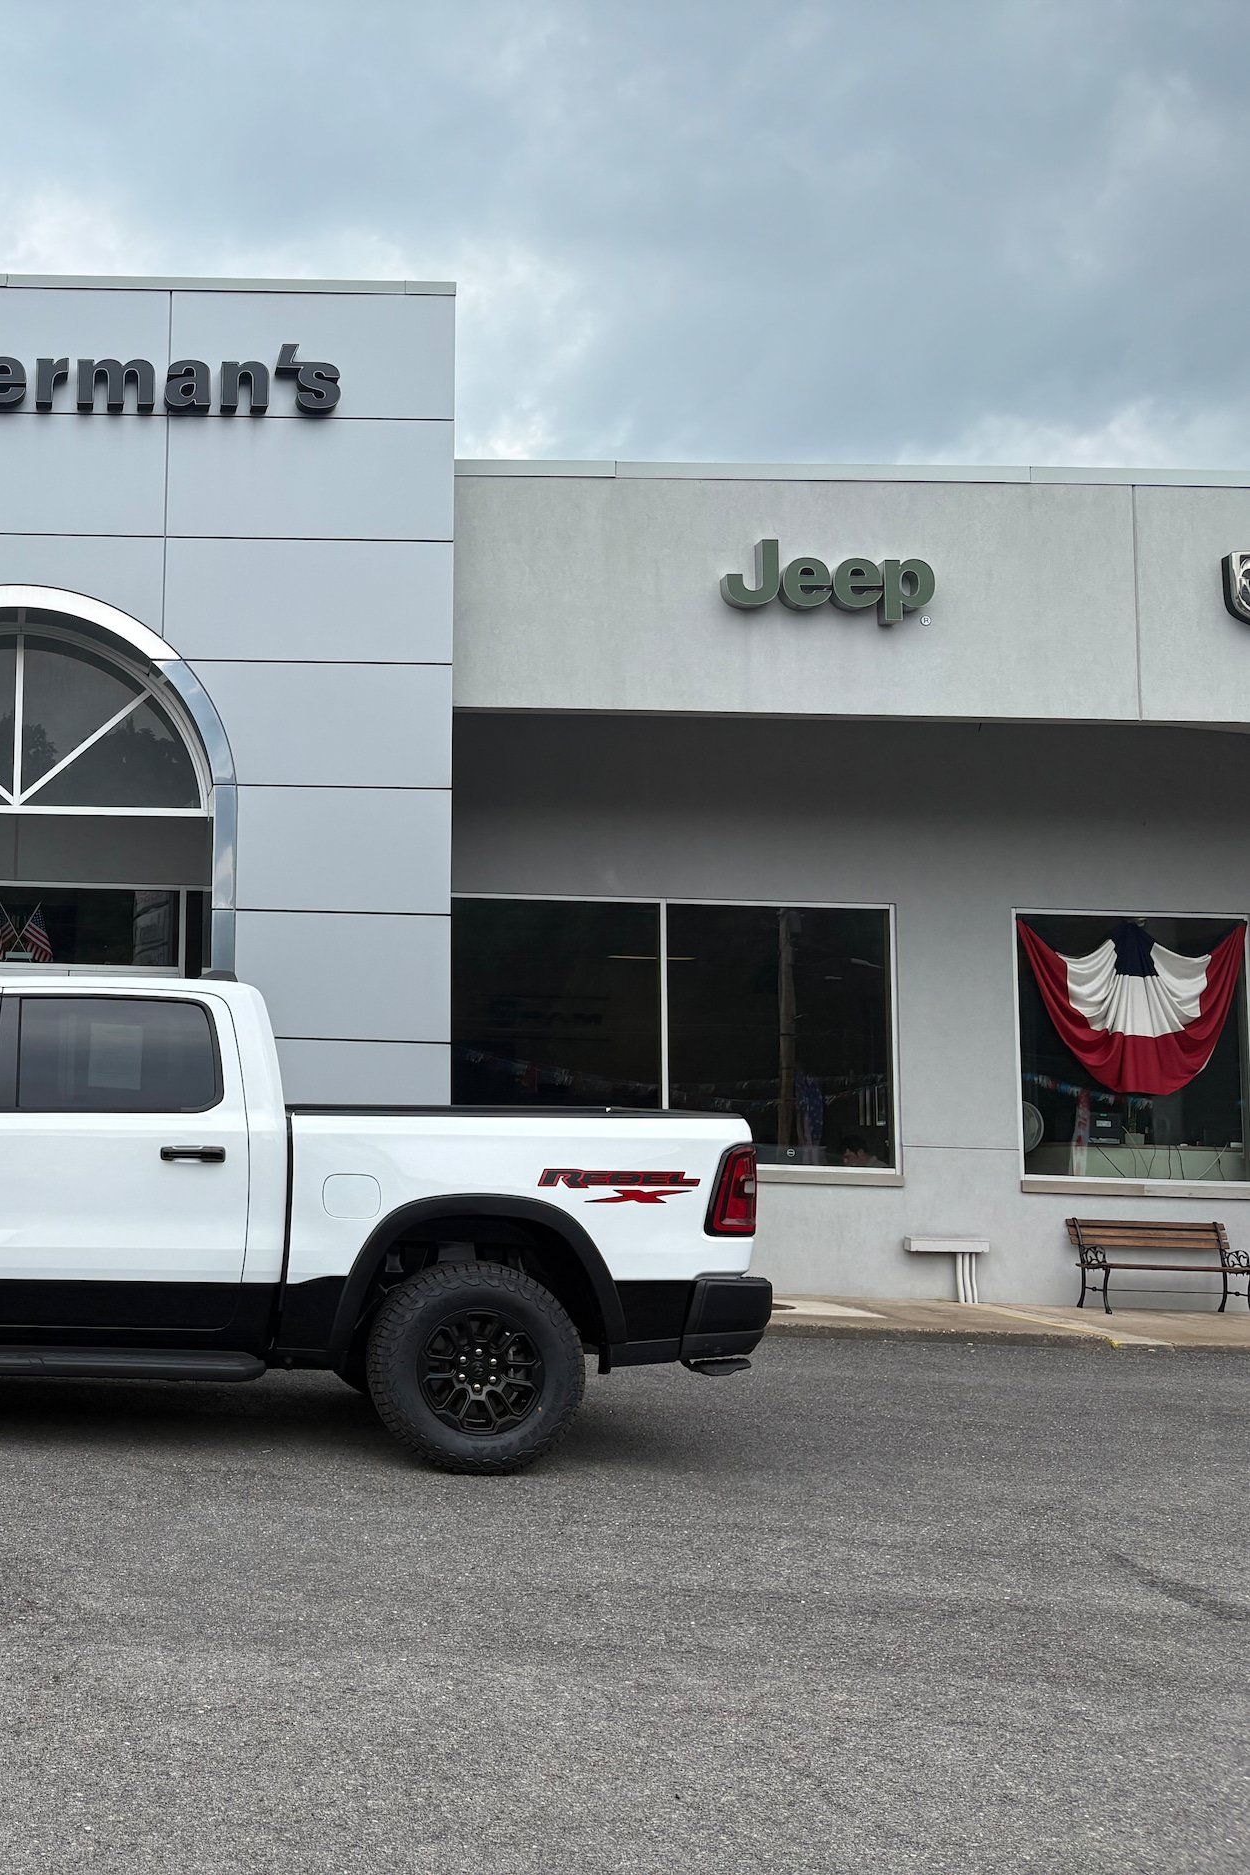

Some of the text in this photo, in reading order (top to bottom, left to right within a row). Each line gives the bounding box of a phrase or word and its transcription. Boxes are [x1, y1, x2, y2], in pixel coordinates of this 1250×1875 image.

[720, 539, 936, 626] Jeep
[537, 1169, 700, 1188] REBEL
[584, 1189, 692, 1204] X
